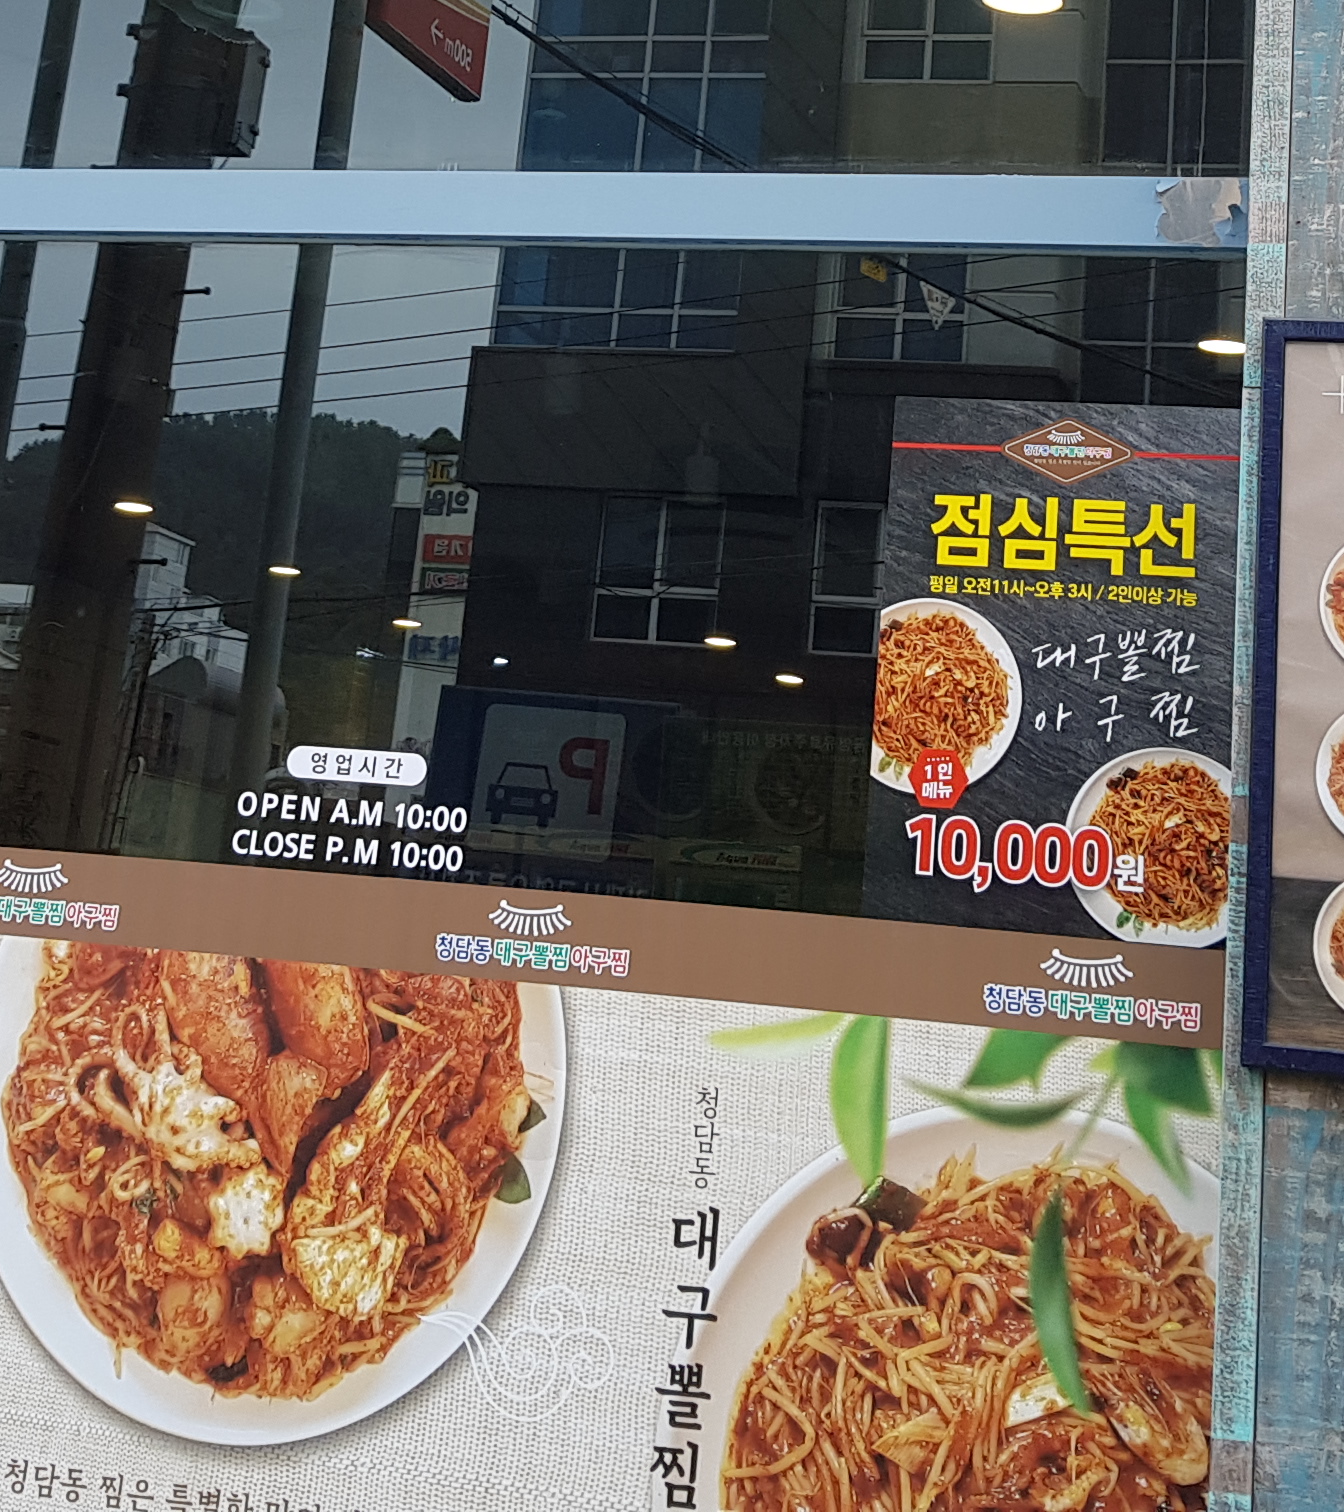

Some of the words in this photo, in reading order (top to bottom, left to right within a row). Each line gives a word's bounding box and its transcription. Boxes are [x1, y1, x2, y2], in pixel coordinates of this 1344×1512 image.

[930, 493, 1197, 578] 점심특선
[929, 575, 959, 594] 평일
[1067, 583, 1093, 602] 3시
[1107, 585, 1164, 605] 2인이상
[1167, 587, 1198, 606] 가능
[1031, 628, 1201, 682] 대구뽈찜
[309, 752, 404, 780] 영업시간
[236, 790, 320, 823] OPEN
[328, 797, 384, 829] A.M
[394, 803, 469, 834] 10:00
[921, 781, 954, 799] 메뉴
[231, 828, 315, 861] CLOSE
[325, 833, 379, 866] P.M
[389, 841, 464, 872] 10:00
[905, 813, 1145, 893] 10,000원
[65, 902, 120, 931] 아구찜
[435, 932, 493, 963] 청담동
[493, 938, 570, 970] 대구뽈찜
[570, 944, 631, 977] 아구찜
[983, 983, 1047, 1014] 청담동
[1048, 989, 1135, 1025] 대구뽈찜
[1136, 998, 1202, 1031] 아구찜
[688, 1086, 721, 1190] 청담동
[649, 1206, 720, 1511] 대구뽈찜
[3, 1458, 87, 1503] 청담동
[99, 1473, 155, 1511] 찜은
